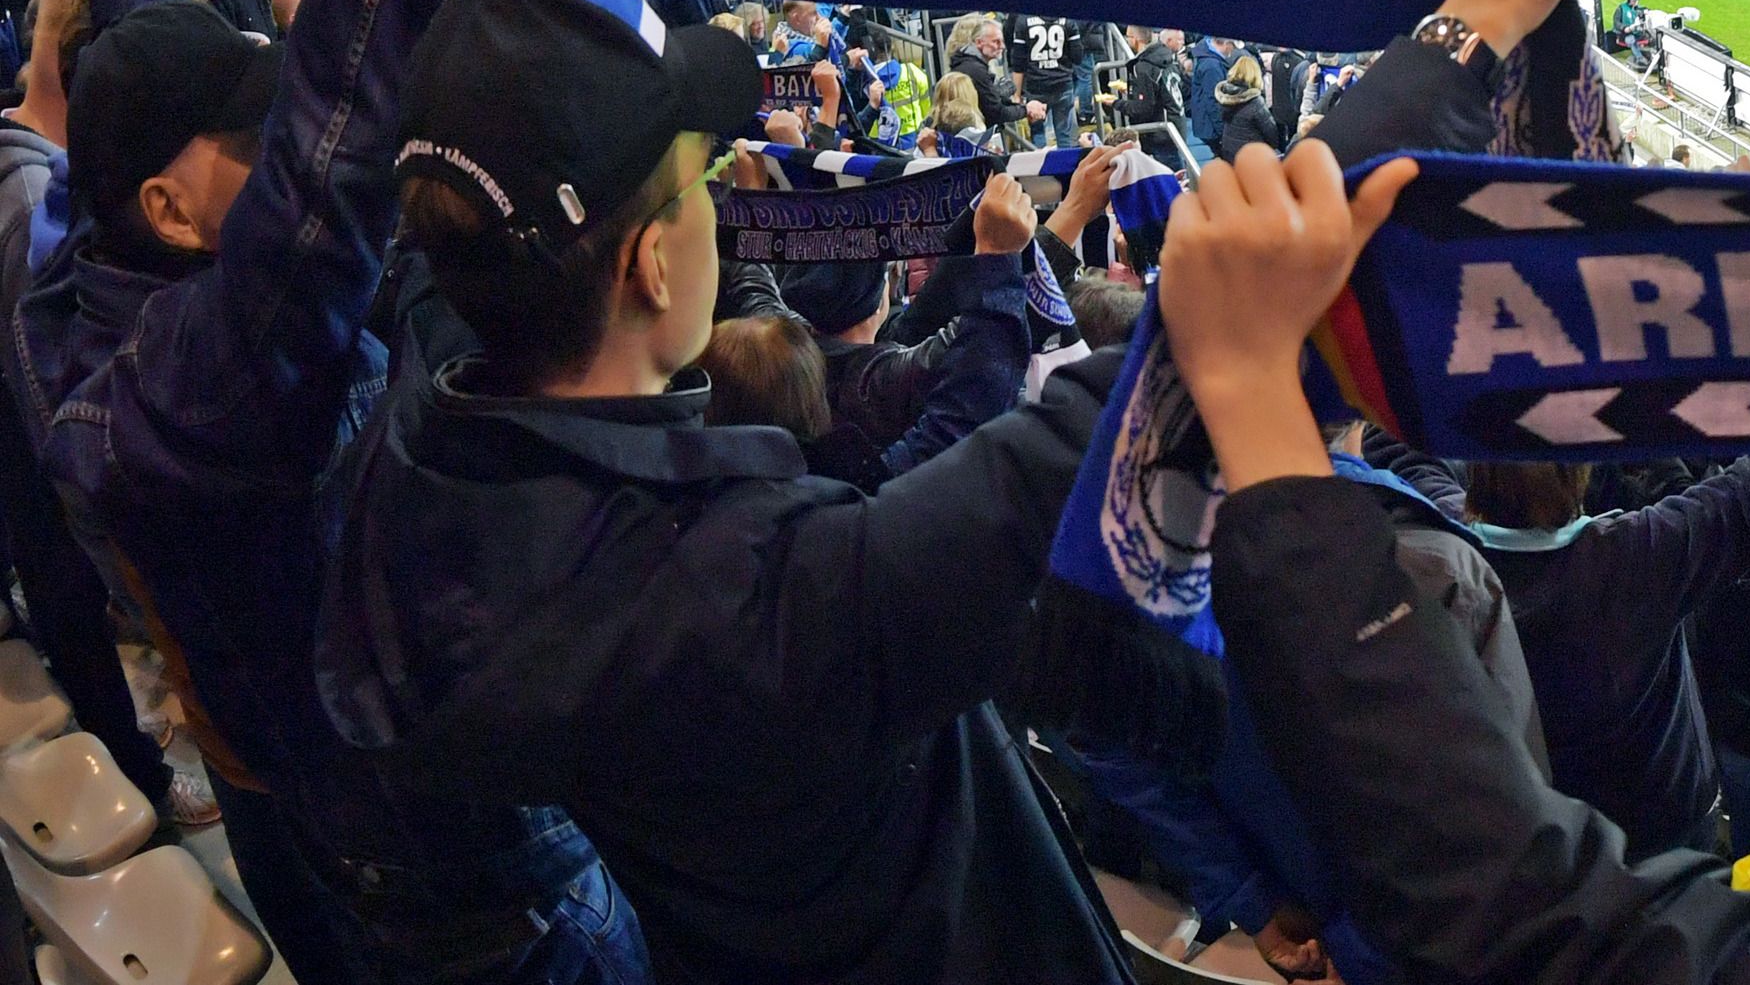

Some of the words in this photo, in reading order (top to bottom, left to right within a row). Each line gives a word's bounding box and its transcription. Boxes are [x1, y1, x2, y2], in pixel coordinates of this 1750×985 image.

[1028, 24, 1065, 62] 29
[736, 229, 773, 259] STUR
[784, 224, 879, 261] HARTNÄCKIG
